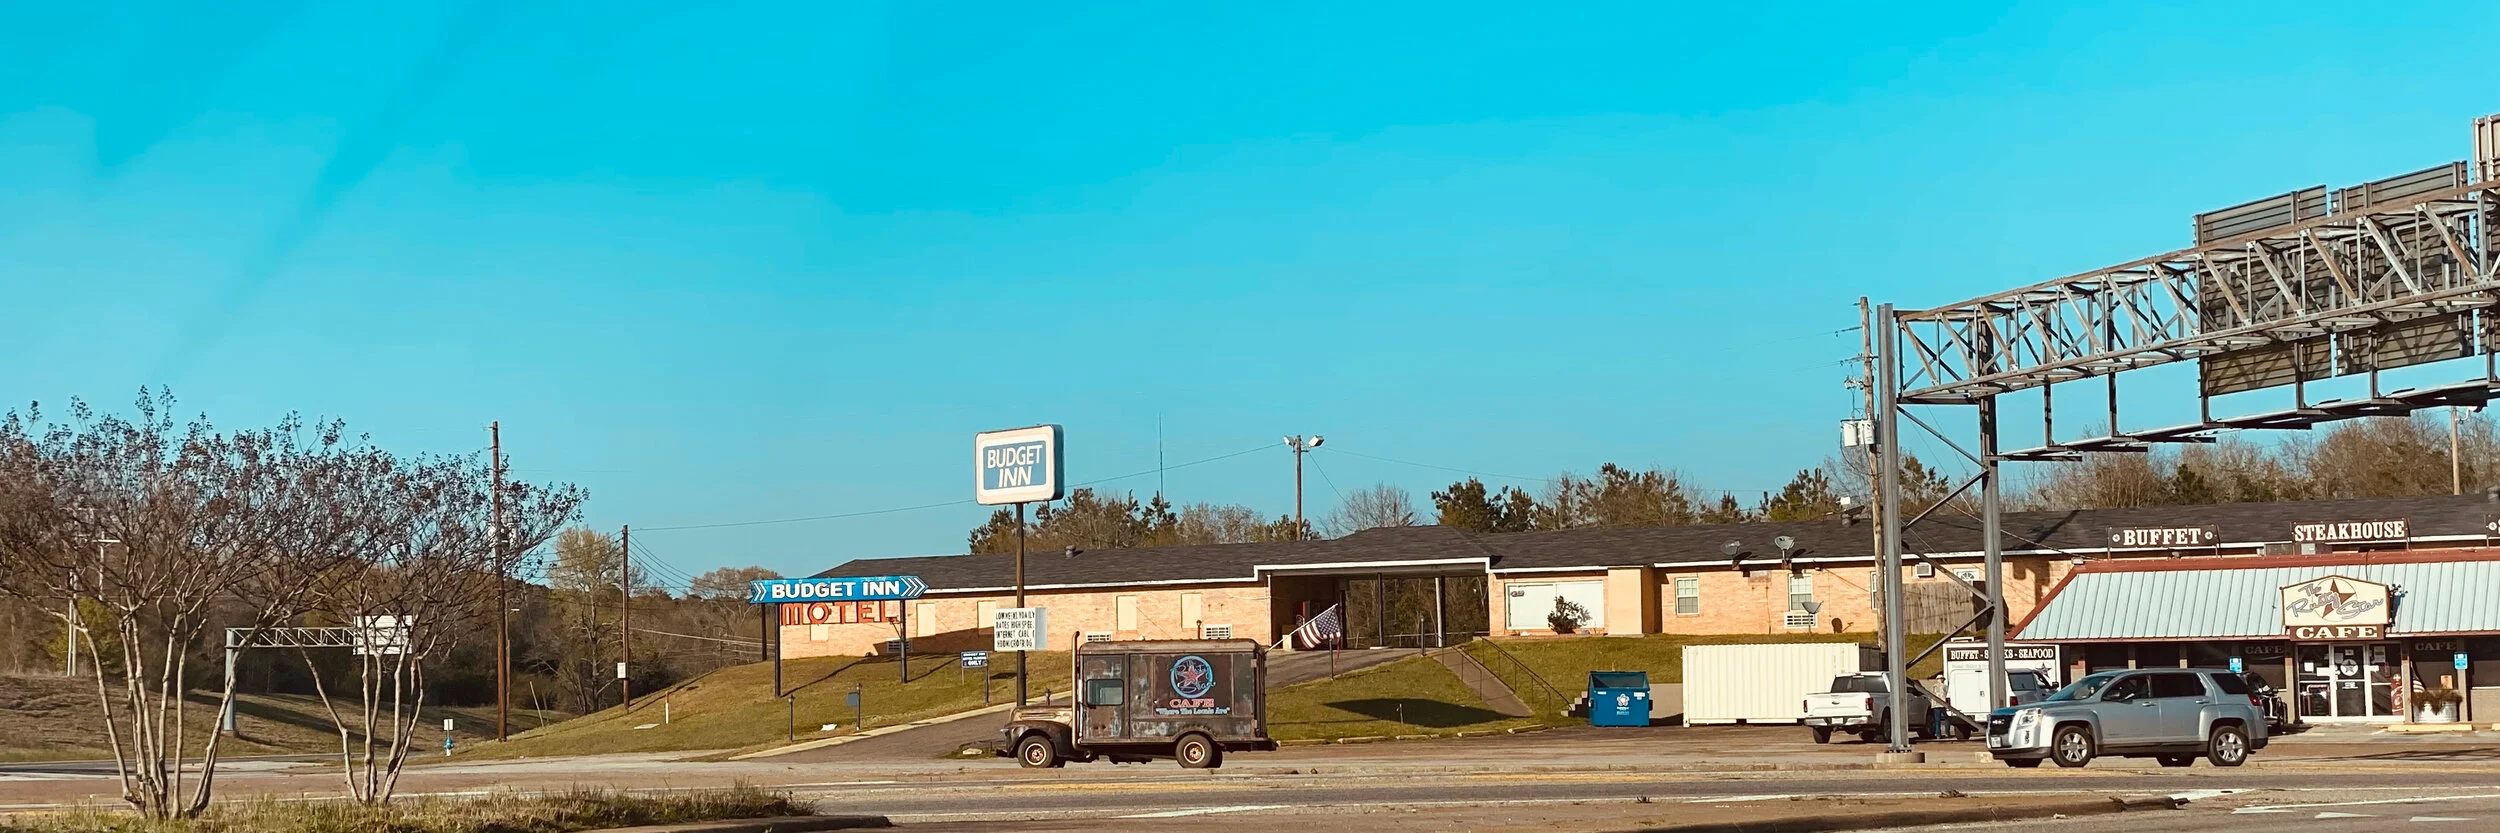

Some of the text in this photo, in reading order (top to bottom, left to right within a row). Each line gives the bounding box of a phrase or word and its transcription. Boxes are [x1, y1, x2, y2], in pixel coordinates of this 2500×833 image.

[987, 445, 1043, 469] BUDGET
[998, 466, 1032, 488] INN
[2123, 528, 2201, 546] BUFFET
[2294, 520, 2405, 542] STEAKHOUSE
[771, 581, 900, 599] BUDGET INN
[2298, 583, 2322, 597] The
[2286, 591, 2384, 620] Rusty Star
[780, 601, 899, 626] MOTEL
[996, 621, 1010, 629] RATES
[2296, 626, 2378, 639] CAFE
[2244, 646, 2284, 655] CAFE
[2414, 641, 2457, 651] CAFE
[1950, 649, 1979, 660] BUFFET
[1984, 649, 2014, 660] SKS
[2018, 648, 2054, 659] SEAFOOD
[1169, 698, 1215, 708] CAFE
[1180, 707, 1193, 715] The
[1193, 707, 1214, 715] Locals
